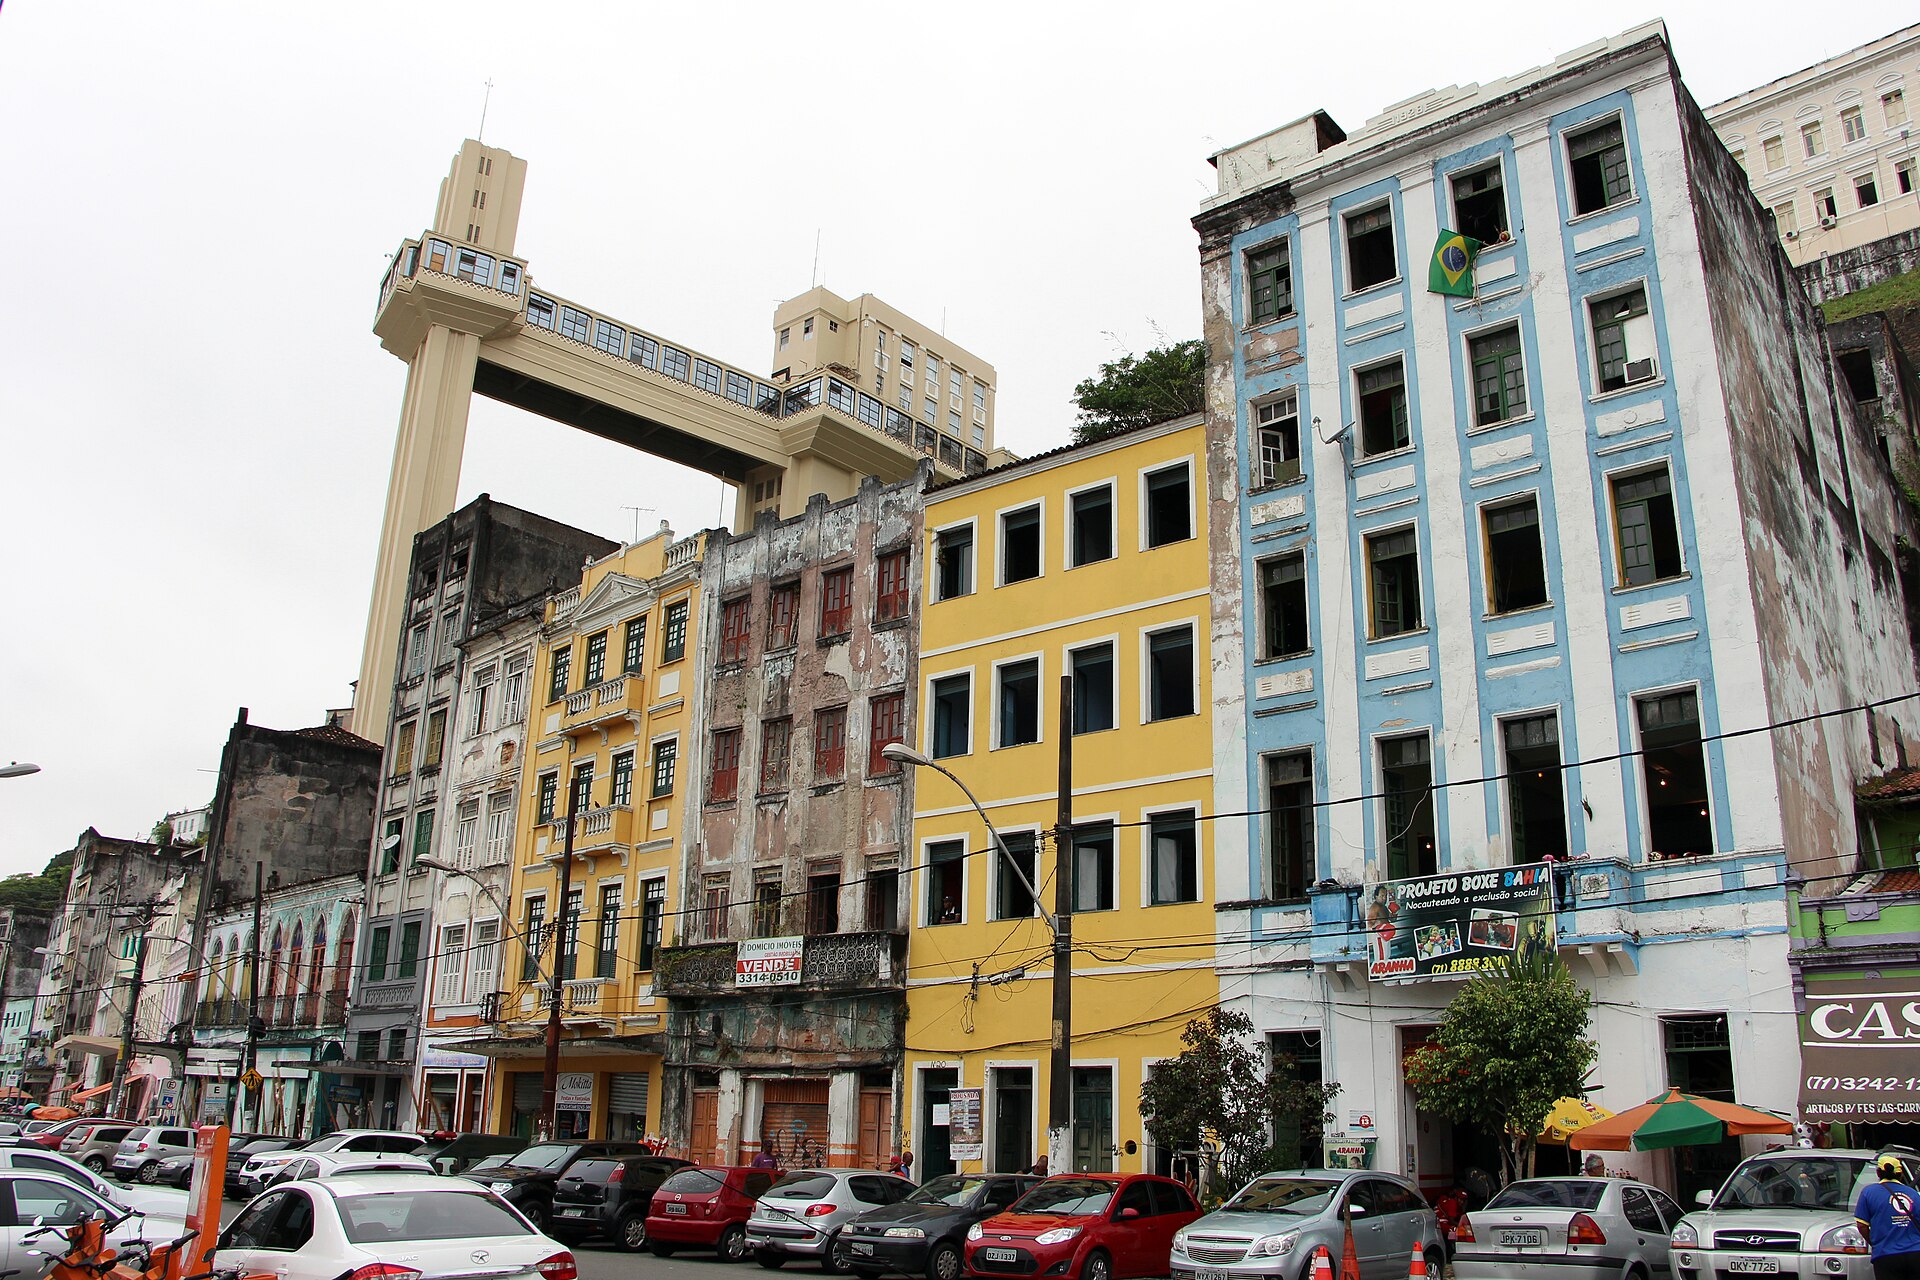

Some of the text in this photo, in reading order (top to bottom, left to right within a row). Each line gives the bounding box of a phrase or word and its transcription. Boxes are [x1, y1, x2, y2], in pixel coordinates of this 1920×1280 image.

[1397, 867, 1549, 899] PROJETO BOXE BAHIA
[1405, 895, 1460, 910] Nocauteando
[1472, 890, 1511, 903] exclusão
[1513, 886, 1540, 898] social
[742, 958, 795, 973] VENDE
[1371, 959, 1414, 974] ARANHA
[1431, 963, 1448, 975] (71)
[738, 971, 798, 983] 3314-0510
[1810, 1001, 1920, 1039] CAS
[214, 1086, 220, 1094] E
[1806, 1104, 1844, 1114] ARTIGOS
[1845, 1104, 1855, 1114] P/
[1500, 1234, 1538, 1244] JPK-7106
[398, 1254, 420, 1263] JAC
